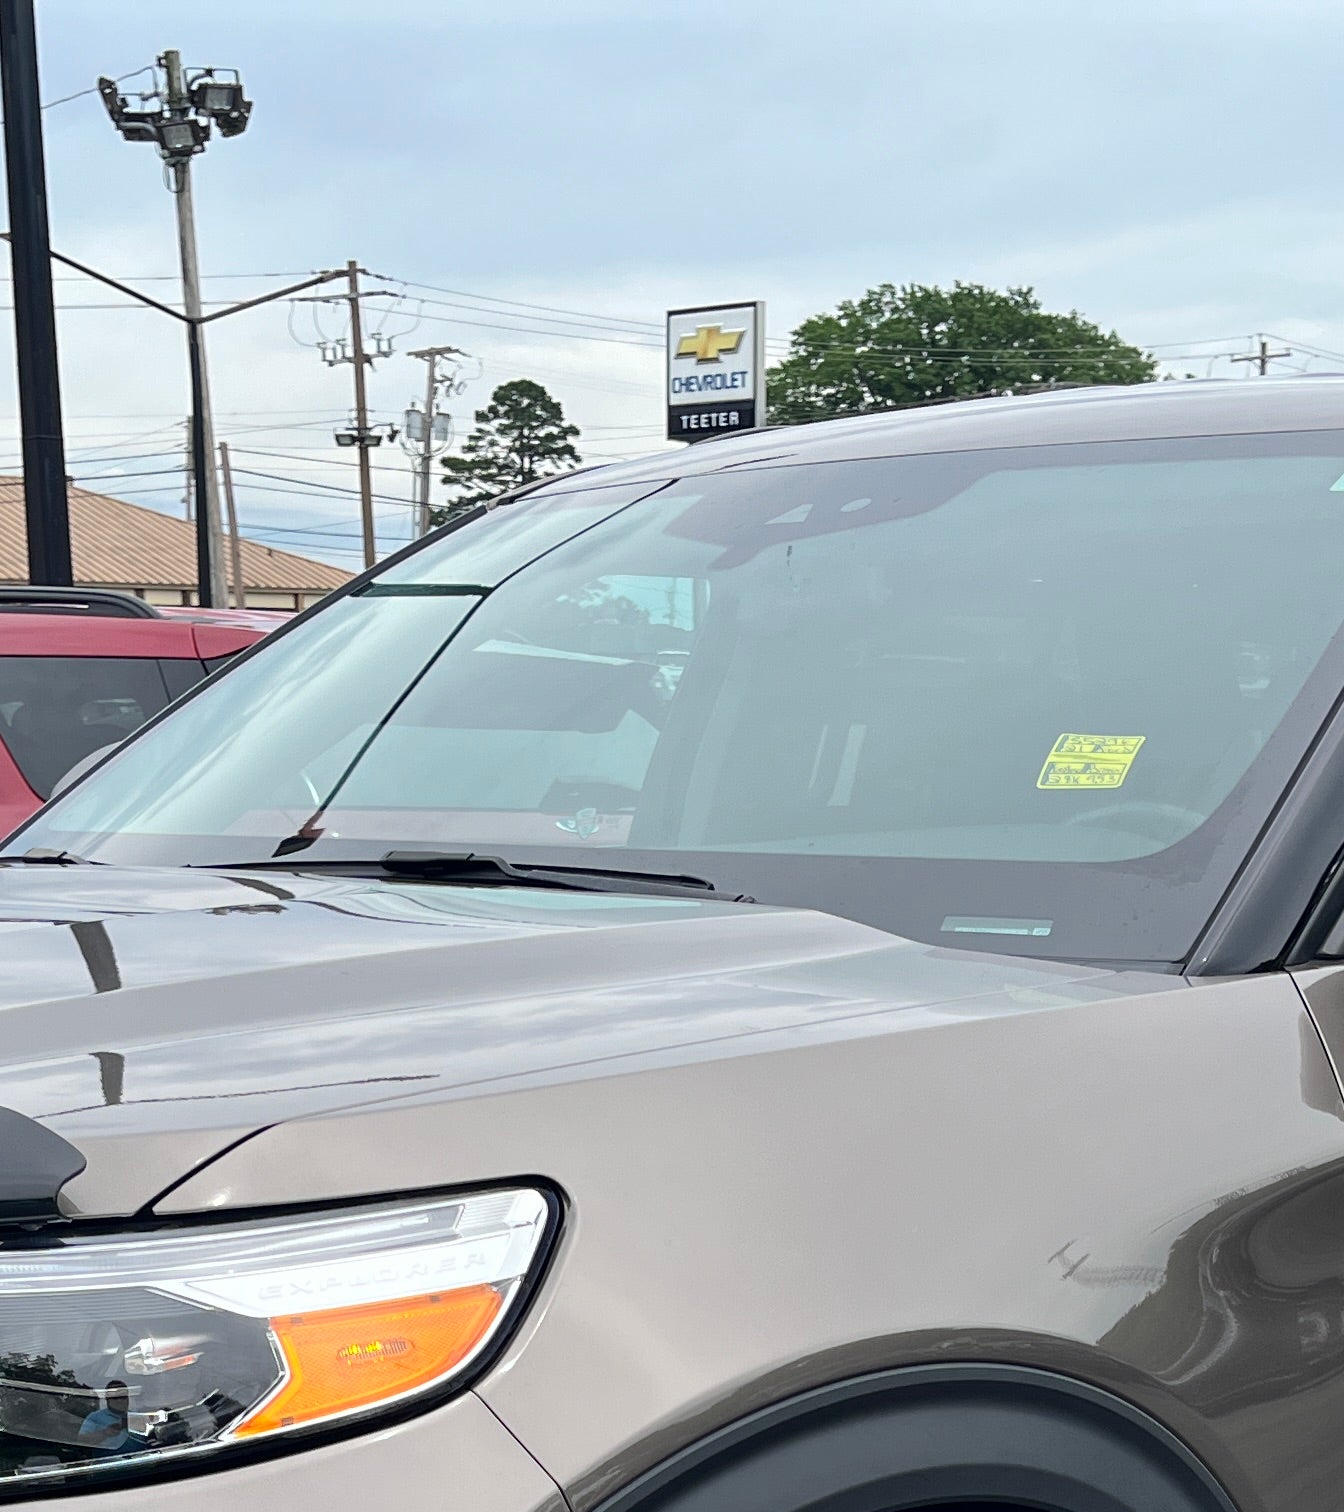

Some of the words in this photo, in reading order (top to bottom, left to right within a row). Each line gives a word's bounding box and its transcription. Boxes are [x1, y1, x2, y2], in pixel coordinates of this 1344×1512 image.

[672, 371, 748, 394] CHEVROLET
[680, 411, 740, 429] TEETER
[257, 1252, 486, 1301] EXPLORER
